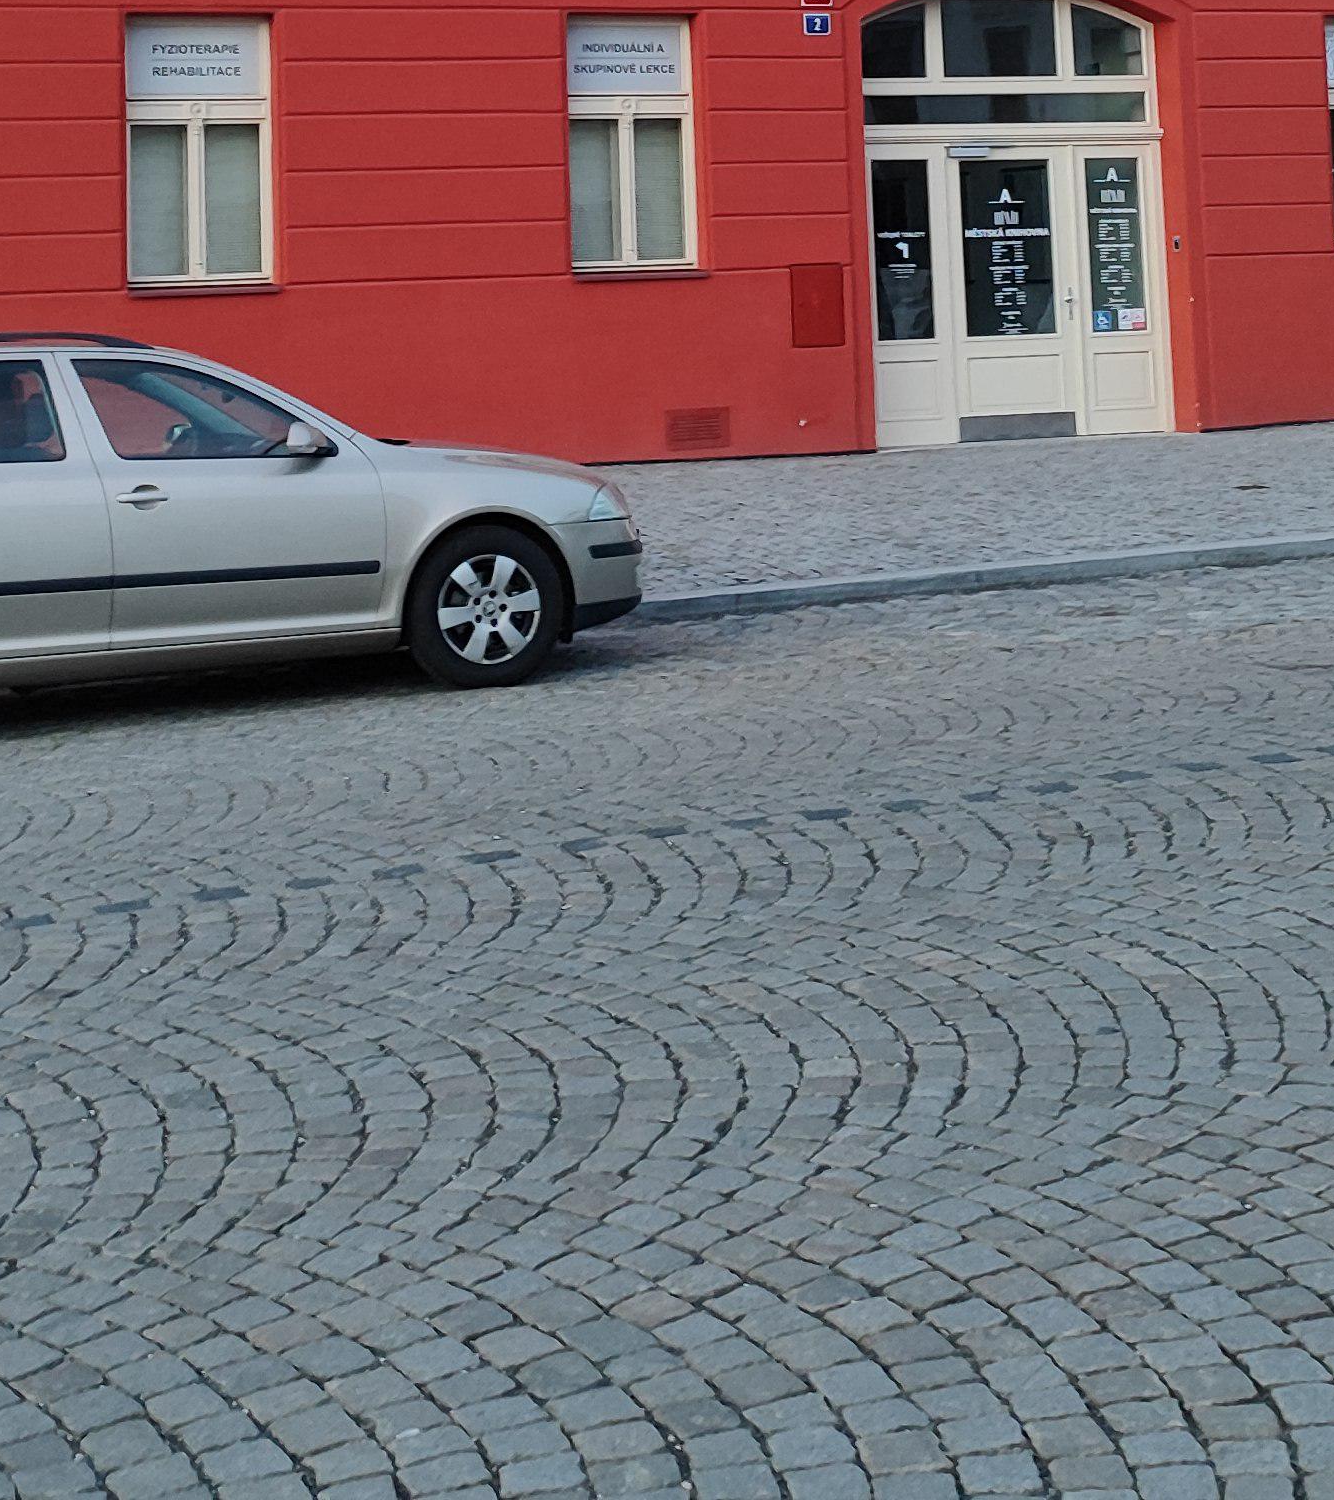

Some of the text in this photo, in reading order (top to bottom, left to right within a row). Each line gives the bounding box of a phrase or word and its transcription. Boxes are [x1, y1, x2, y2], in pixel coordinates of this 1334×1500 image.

[152, 44, 240, 55] FYZIOTERAPIE
[582, 41, 665, 53] INDIVIDUÁLNÍ A
[152, 66, 242, 77] REHABILITACE
[573, 63, 675, 74] SKUPINOVÉ LEKCE
